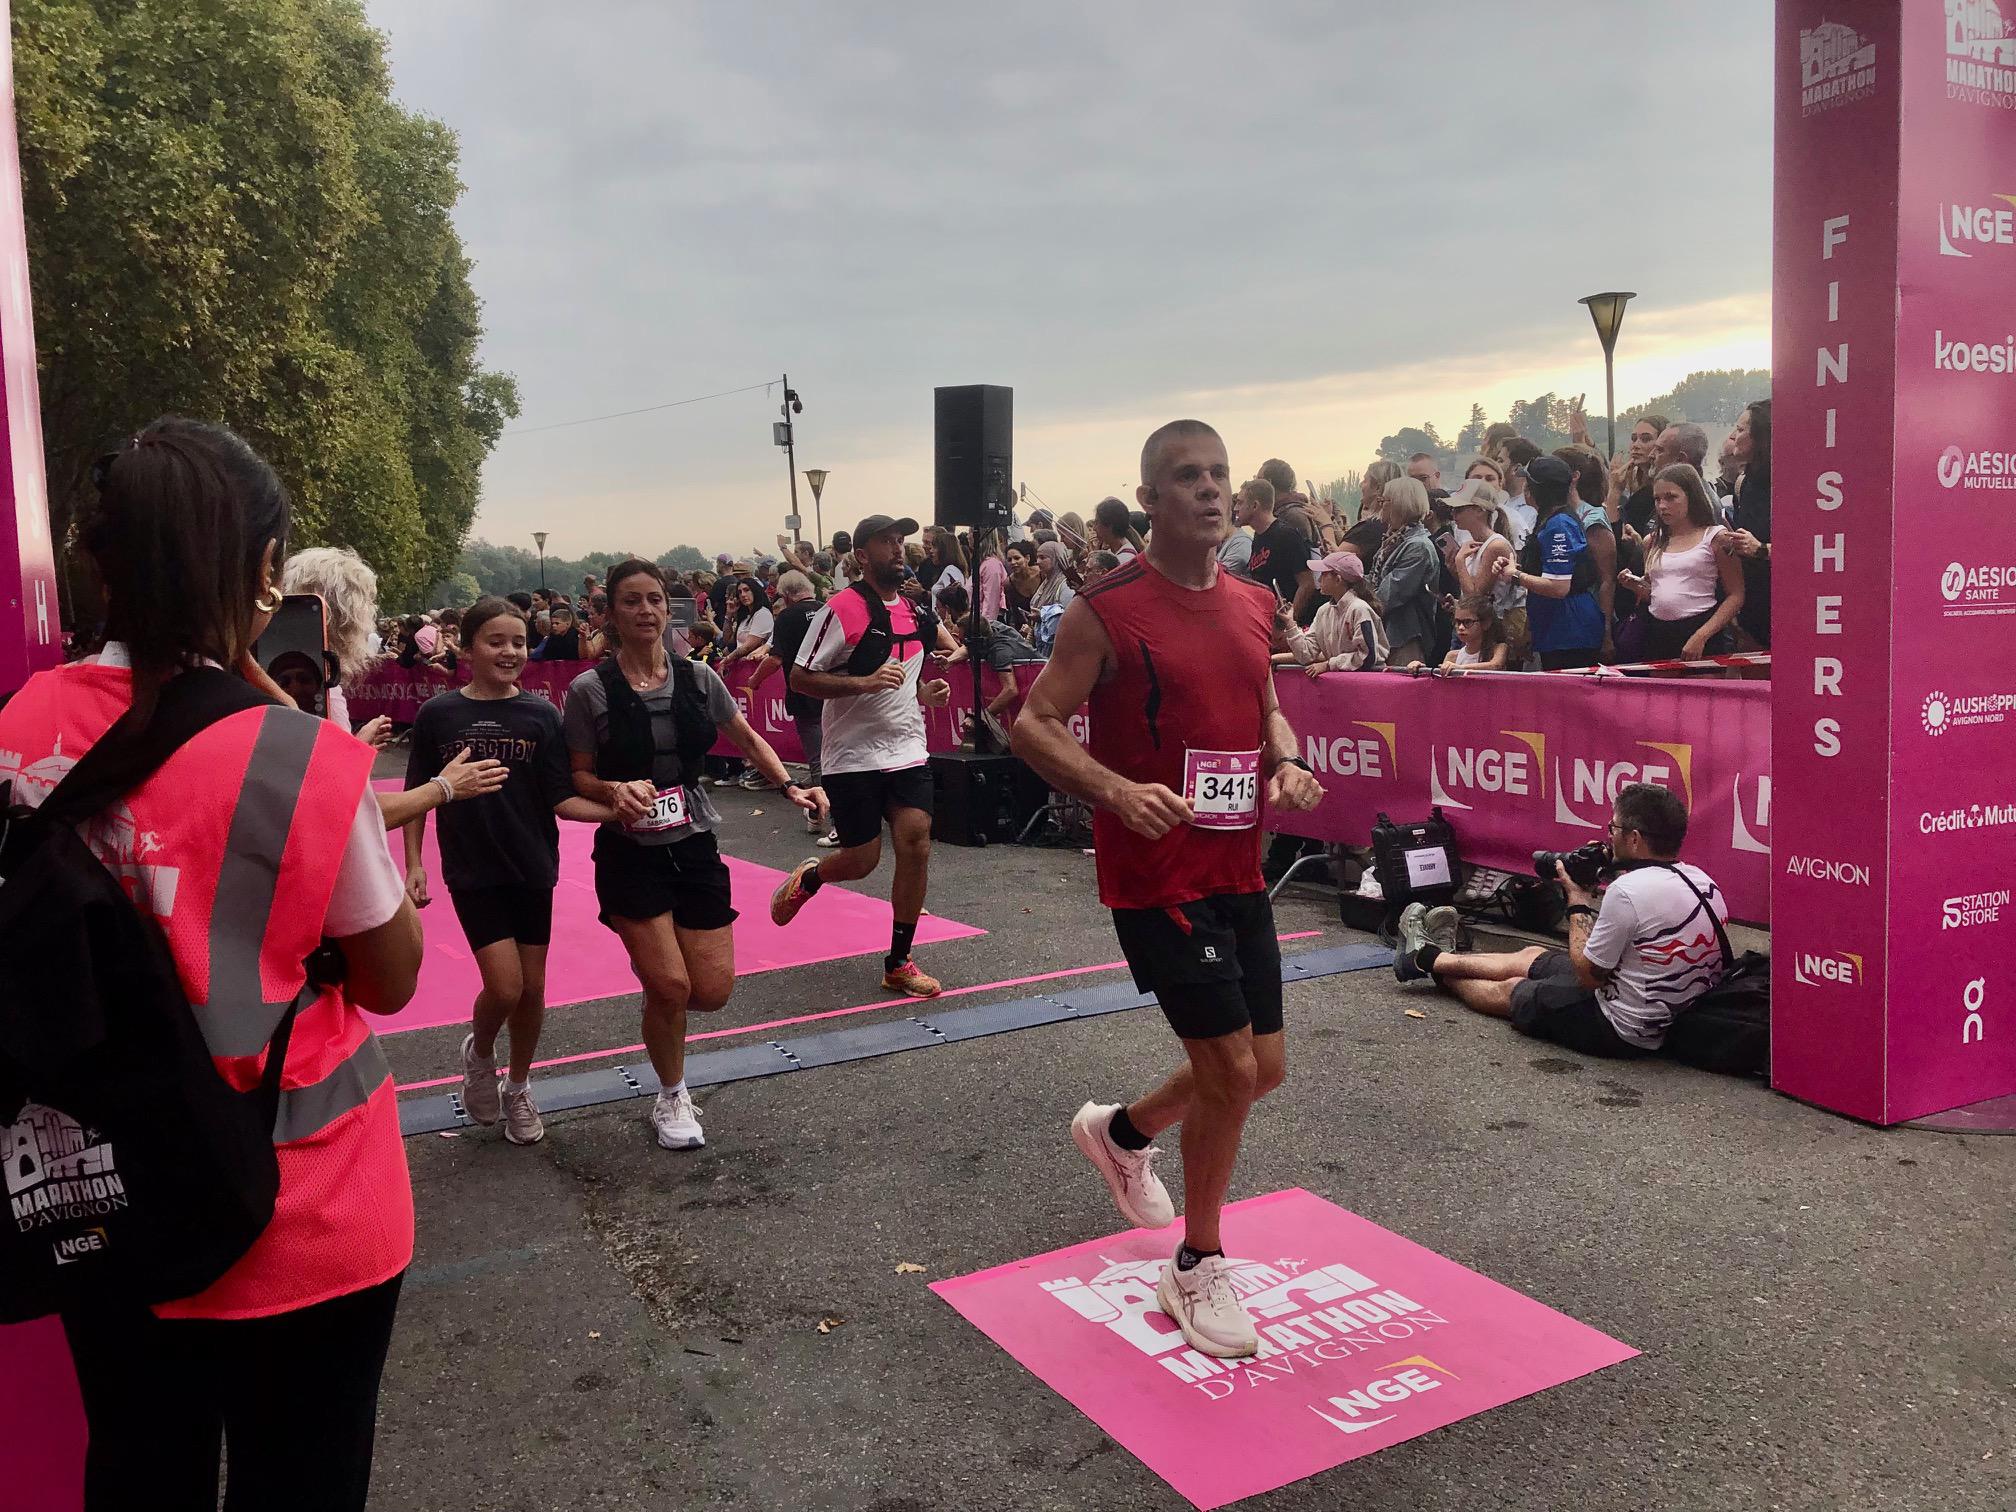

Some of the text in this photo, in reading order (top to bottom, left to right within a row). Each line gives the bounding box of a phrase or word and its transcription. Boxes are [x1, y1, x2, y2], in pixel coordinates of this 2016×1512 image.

[1802, 66, 1876, 107] MARATHON
[1946, 58, 2016, 95] MARATHO
[1946, 83, 2016, 110] D'AVIGNO
[1952, 204, 2014, 244] NGE
[1935, 329, 2016, 374] koesi
[1814, 214, 1850, 757] FINISHERS
[1965, 588, 2000, 600] SANTÉ
[1953, 713, 2005, 727] AVIGNON NORD
[1306, 735, 1382, 778] NGE
[1448, 746, 1528, 795] NGE
[1203, 776, 1255, 800] 3415
[1228, 803, 1239, 811] RUI
[1920, 804, 2016, 833] Crédit Mut
[1787, 855, 1870, 887] AVIGNON
[1962, 907, 2000, 927] STORE
[1963, 890, 2010, 911] STATION
[1804, 955, 1853, 985] NGE
[11, 1173, 125, 1220] MARATHON
[18, 1194, 129, 1233] D'AVIGNON
[61, 1235, 102, 1256] NGE
[1194, 1309, 1449, 1400] D'AVIGNON
[1328, 1368, 1442, 1418] NGE
